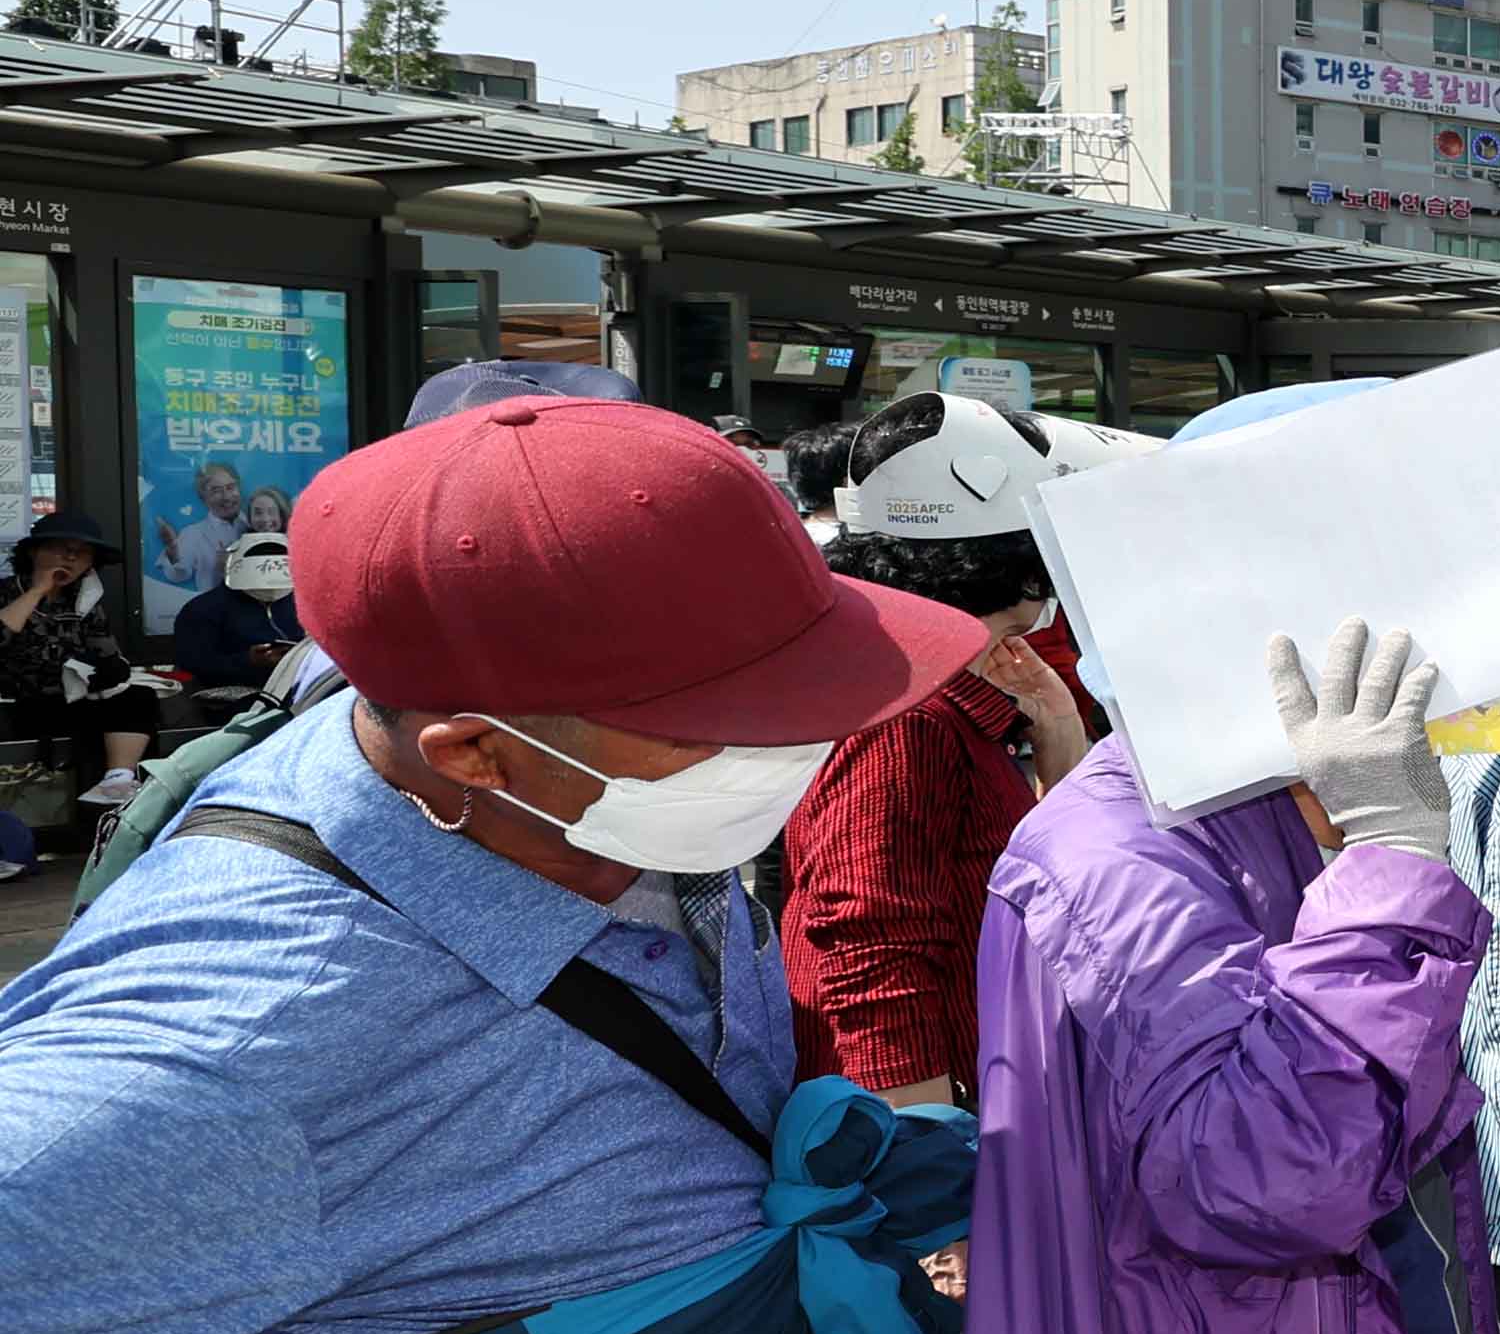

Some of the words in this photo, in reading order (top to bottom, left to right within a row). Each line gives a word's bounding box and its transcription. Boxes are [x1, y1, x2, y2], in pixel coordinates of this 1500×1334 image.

[1314, 57, 1375, 91] 대왕
[1380, 66, 1491, 108] 숯불갈비
[1308, 180, 1334, 205] 큐
[1342, 184, 1473, 220] 노래연습장
[32, 222, 70, 236] Market
[166, 416, 324, 453] 받으세요
[887, 514, 939, 525] INCHEON
